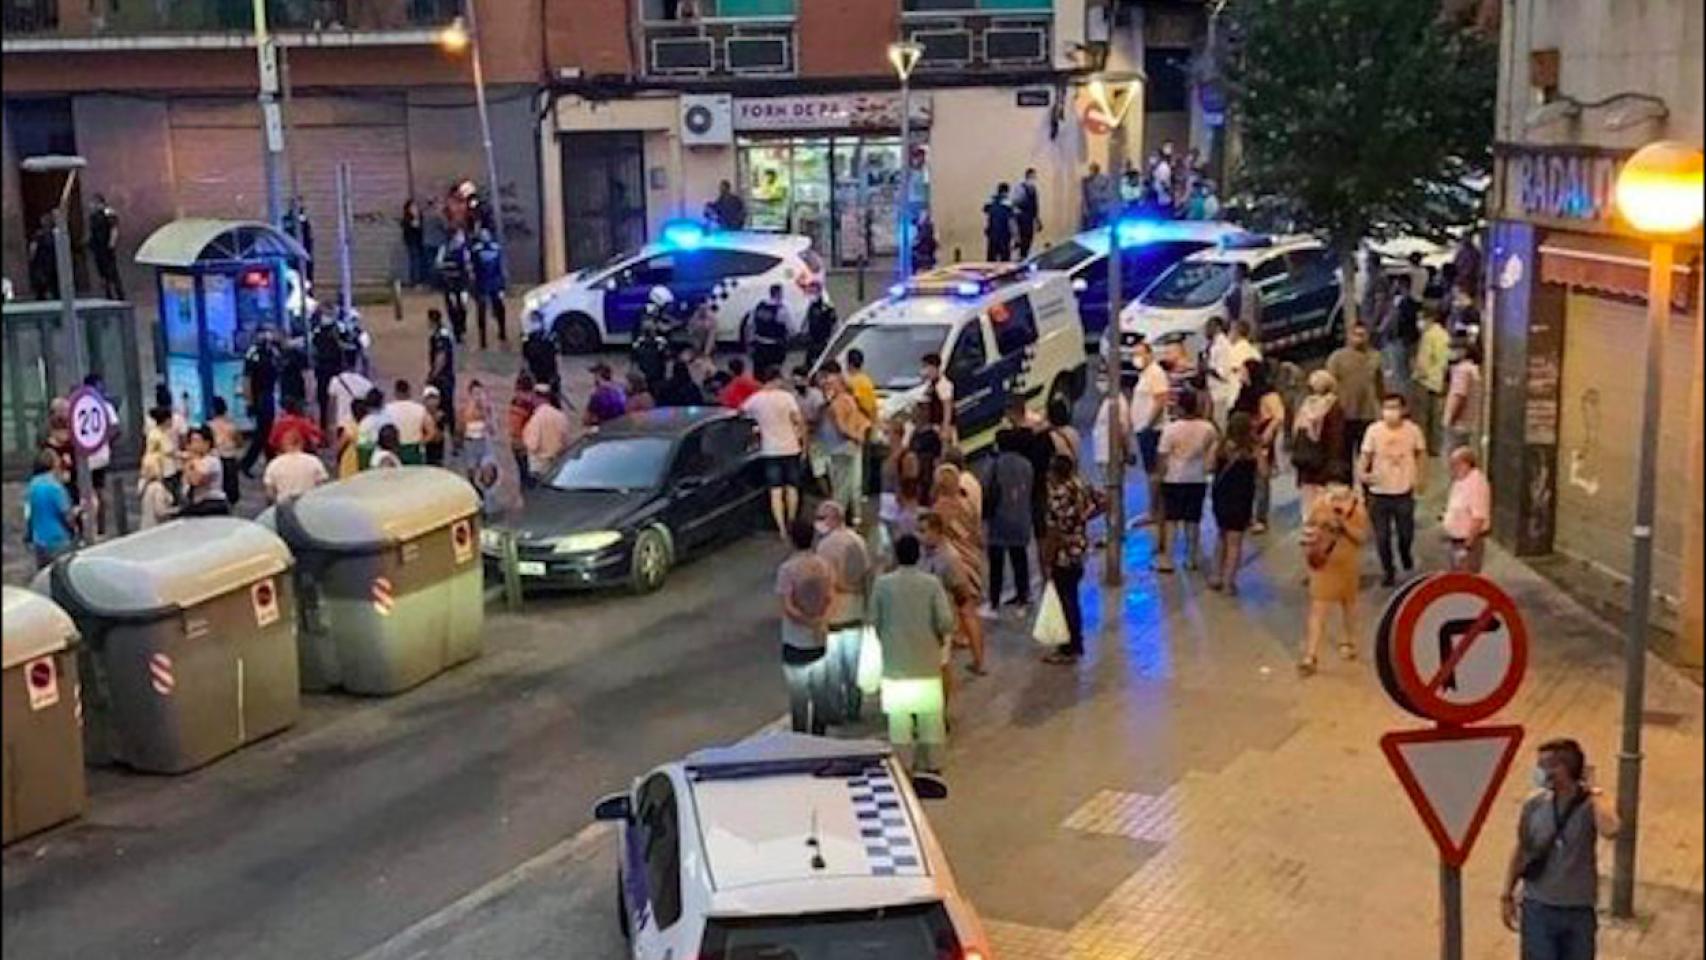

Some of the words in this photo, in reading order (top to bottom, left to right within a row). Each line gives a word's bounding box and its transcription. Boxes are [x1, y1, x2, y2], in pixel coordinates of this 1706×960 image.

[793, 102, 814, 117] DE
[1516, 154, 1615, 219] BADALO
[78, 407, 101, 436] 20
